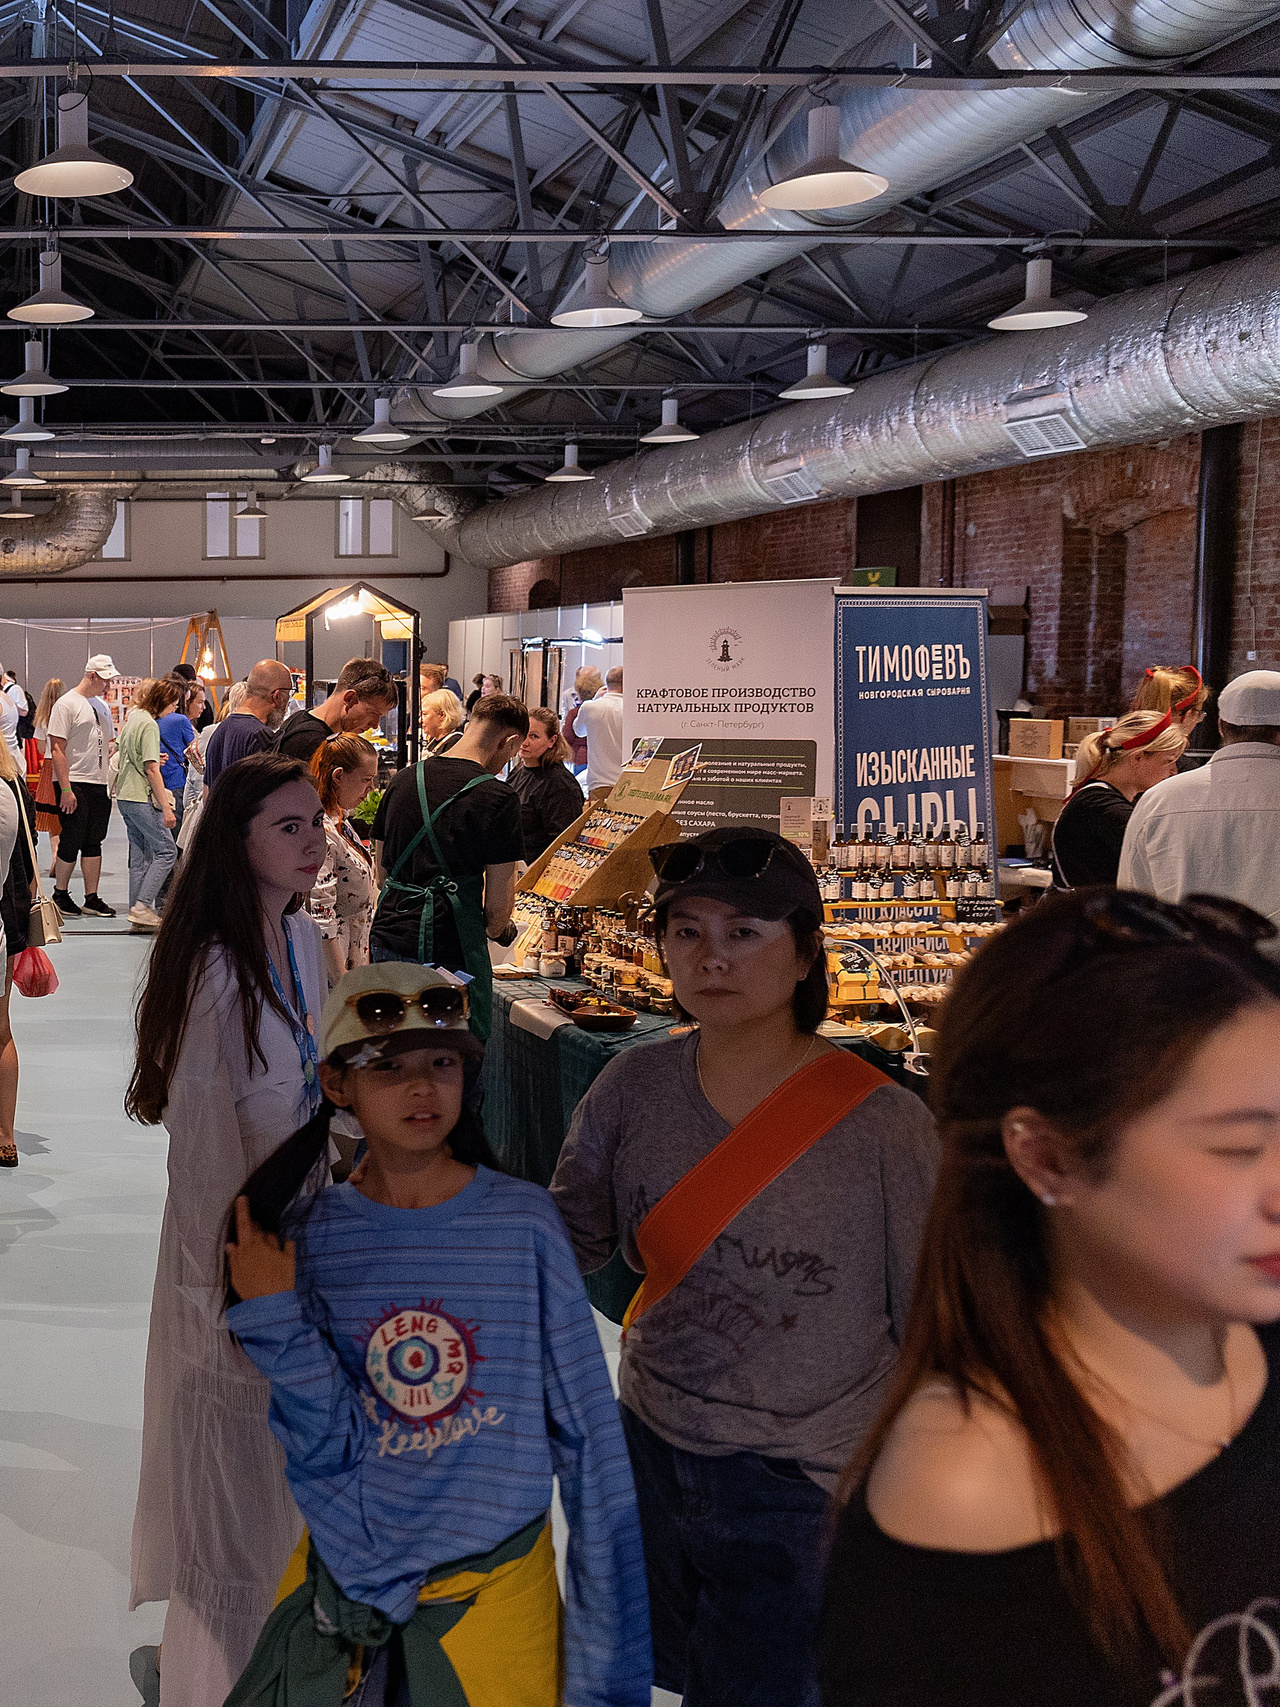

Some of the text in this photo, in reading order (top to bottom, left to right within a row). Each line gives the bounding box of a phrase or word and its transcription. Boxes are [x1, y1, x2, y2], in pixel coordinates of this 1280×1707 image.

[636, 687, 817, 700] КРАФТОВОЕ ПРОИЗВОДСТВО
[858, 686, 971, 700] НОВГОРОДСКАЯ СЫРОВАРНЯ
[637, 702, 815, 715] НАТУРАЛЬНЫХ ПРОДУКТОВ
[690, 719, 765, 730] Санкт-Петербург)
[856, 744, 976, 788] ИЗЫСКАННЫЕ
[688, 820, 716, 828] САХАРА
[381, 1315, 440, 1347] LENG
